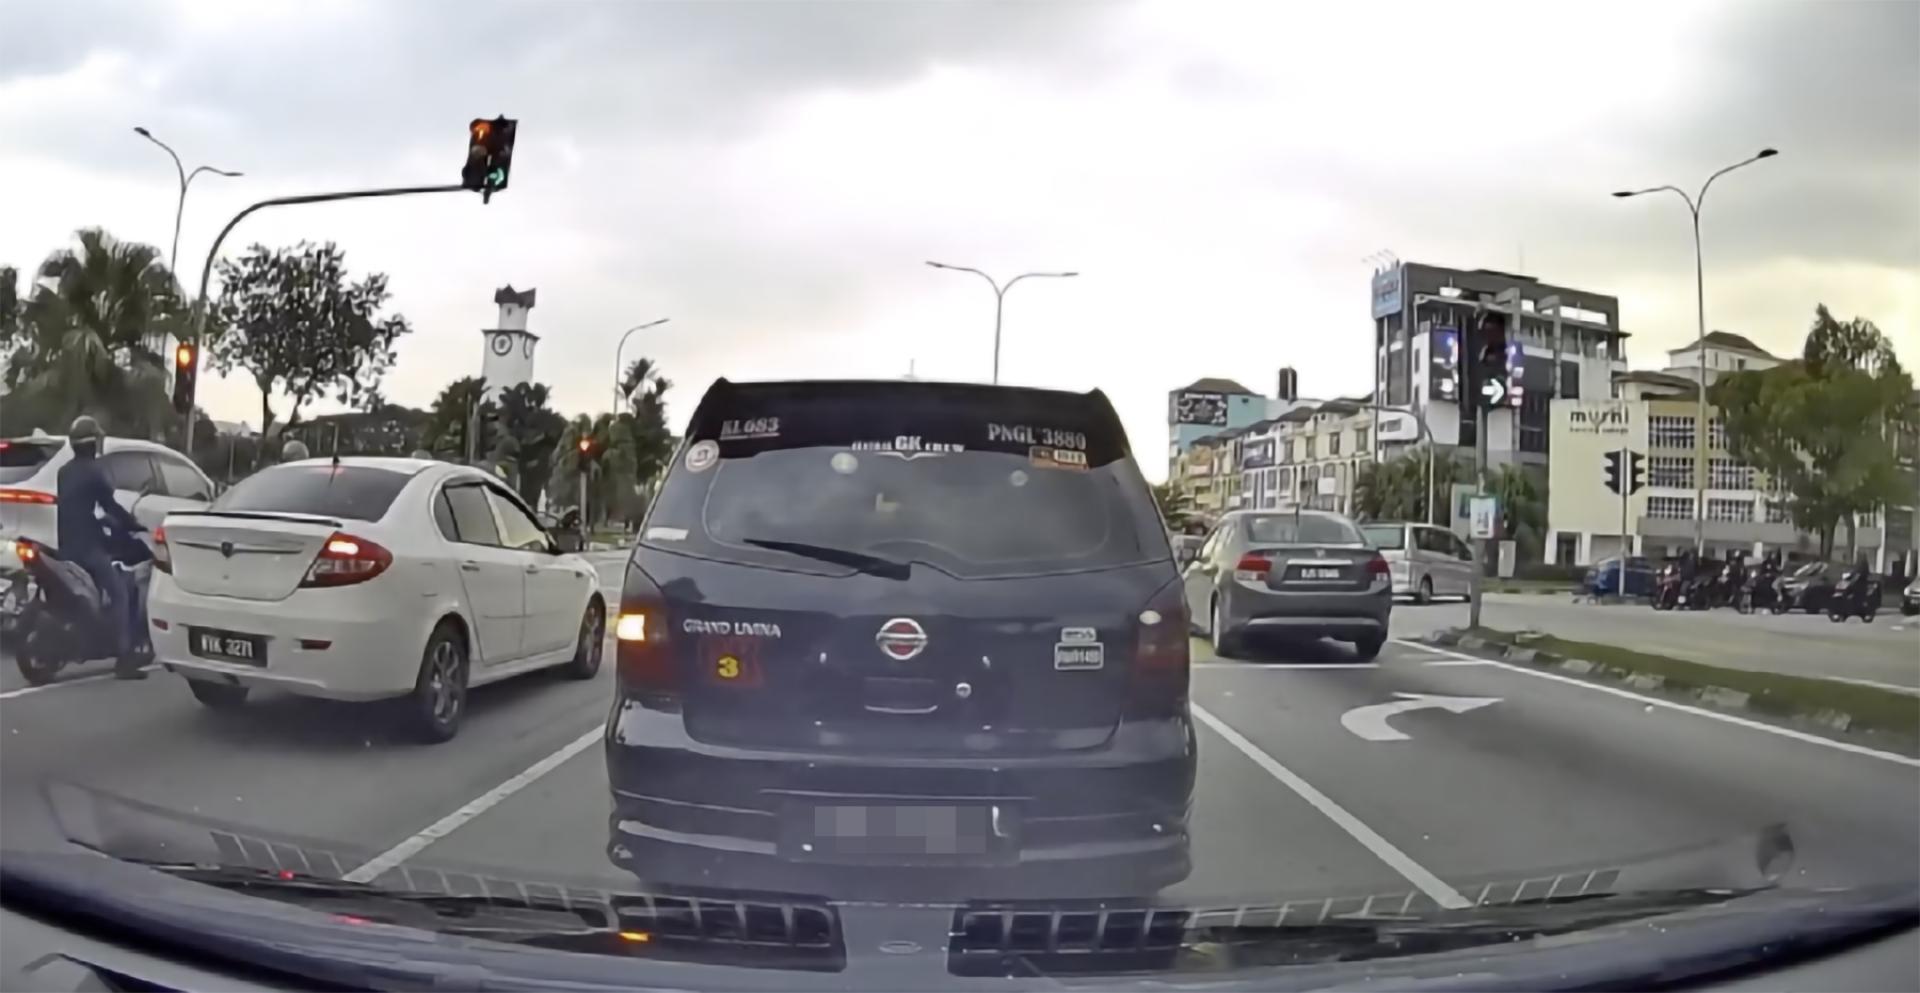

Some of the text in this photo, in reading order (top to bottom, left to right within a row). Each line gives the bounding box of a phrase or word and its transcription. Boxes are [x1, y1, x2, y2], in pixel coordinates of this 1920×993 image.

[988, 423, 1036, 444] PNGL
[683, 618, 731, 635] GRAND
[718, 656, 739, 678] 3
